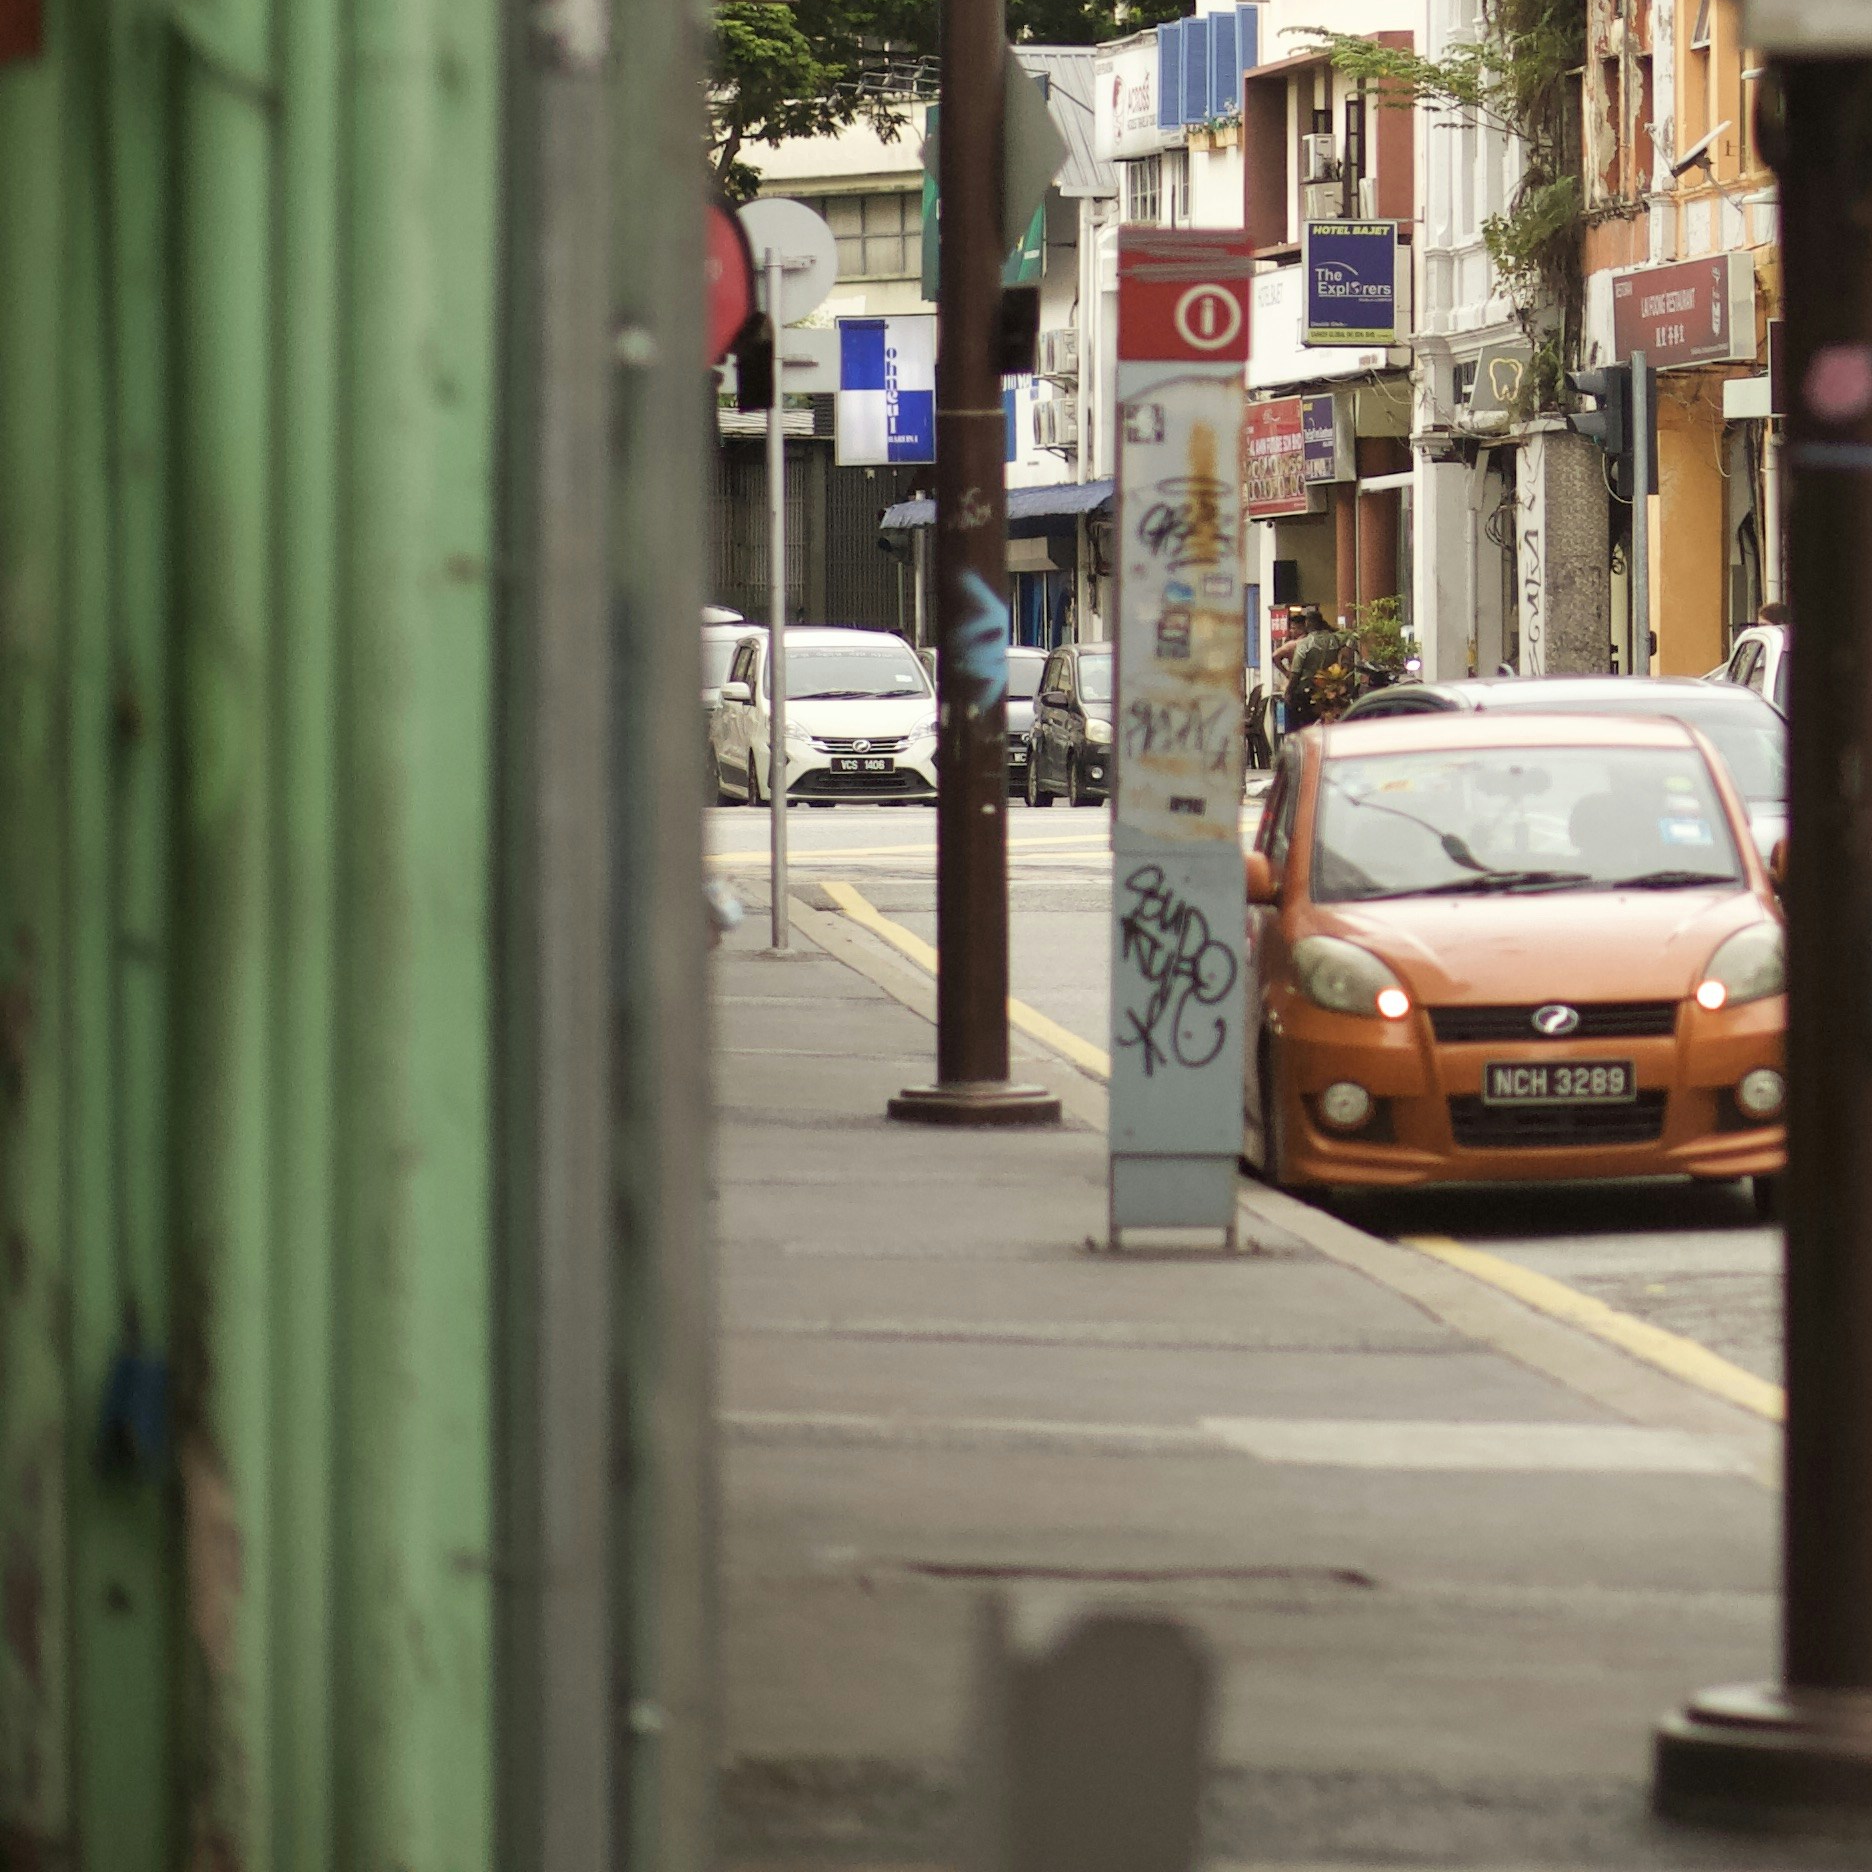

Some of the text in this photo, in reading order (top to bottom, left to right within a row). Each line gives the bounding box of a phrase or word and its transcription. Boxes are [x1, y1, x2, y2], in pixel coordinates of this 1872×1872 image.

[1313, 226, 1390, 236] HOTEL BAJET
[1315, 268, 1342, 281] The
[841, 759, 858, 770] VCS
[1493, 1068, 1547, 1096] NCH
